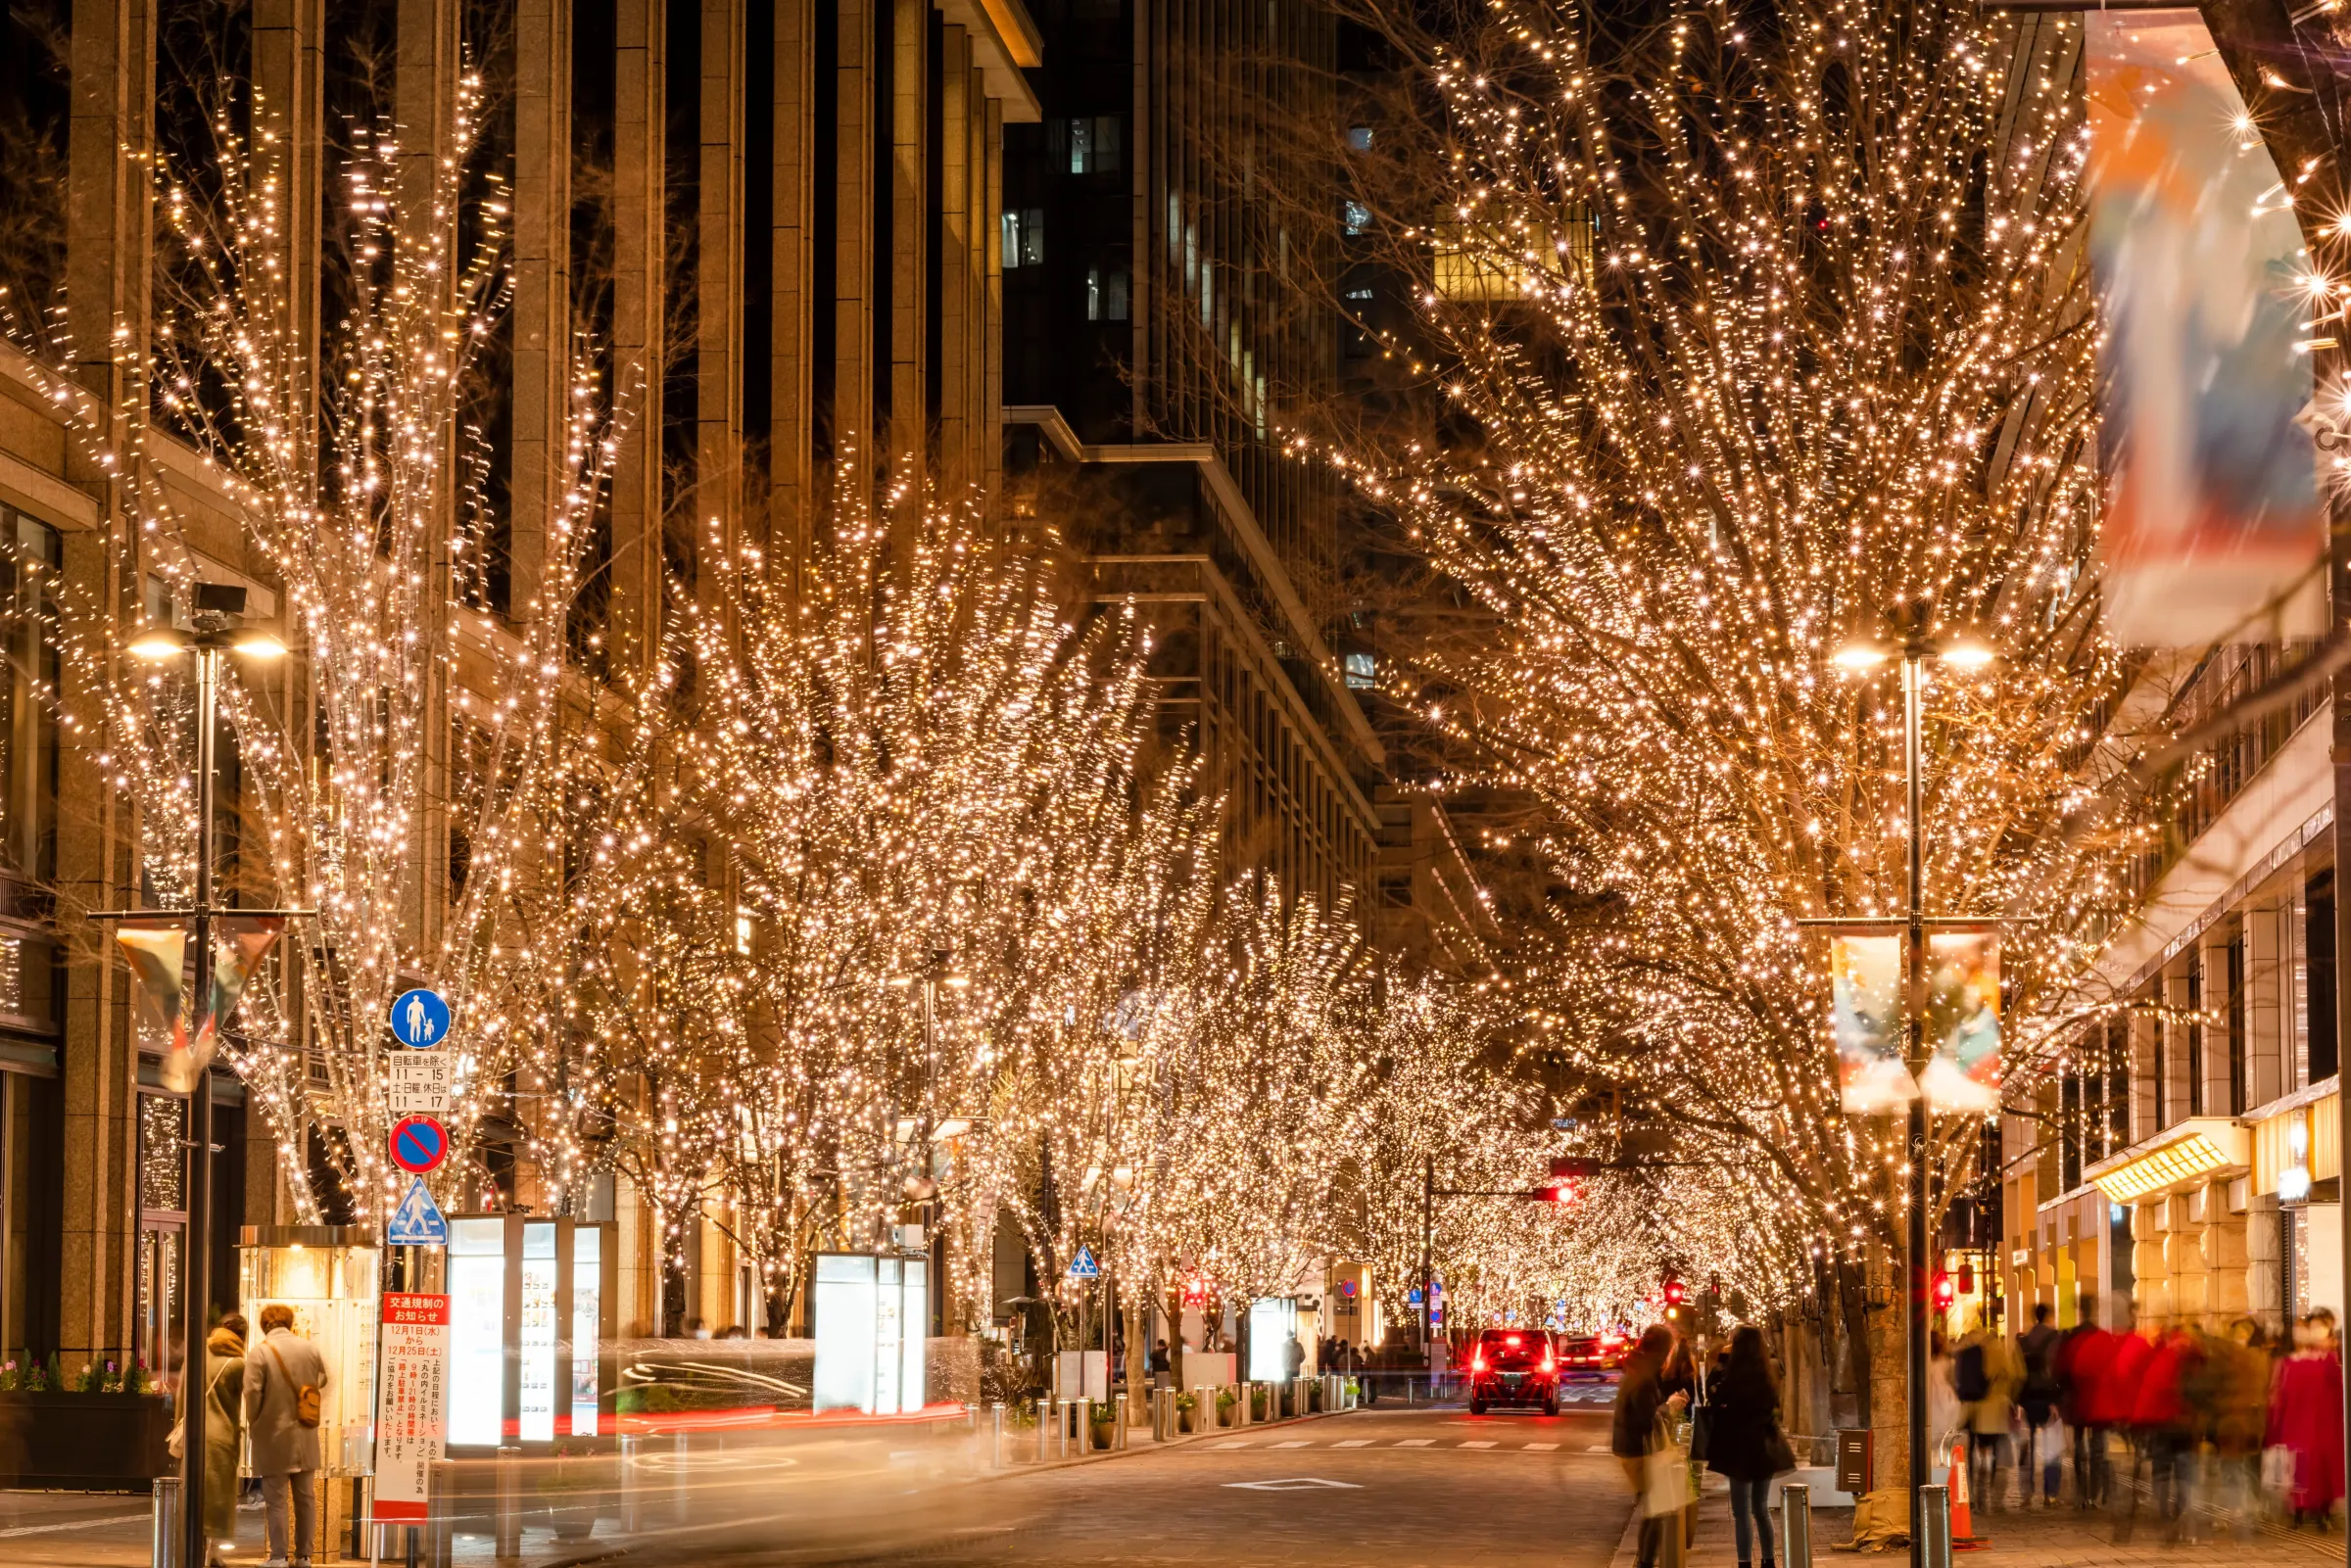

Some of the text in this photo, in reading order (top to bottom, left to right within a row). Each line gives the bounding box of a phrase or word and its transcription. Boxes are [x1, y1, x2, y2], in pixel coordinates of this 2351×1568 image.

[394, 1055, 447, 1067] 自転車を除く
[432, 1069, 444, 1080] 15
[431, 1096, 443, 1108] 17
[390, 1297, 444, 1309] 交通規制の
[395, 1310, 438, 1322] お知らせ
[391, 1325, 441, 1336] 12月1日(水)
[406, 1336, 424, 1346] から
[388, 1346, 443, 1357] 12月25日(土)
[383, 1356, 396, 1458] ご協力をお願いいたします。
